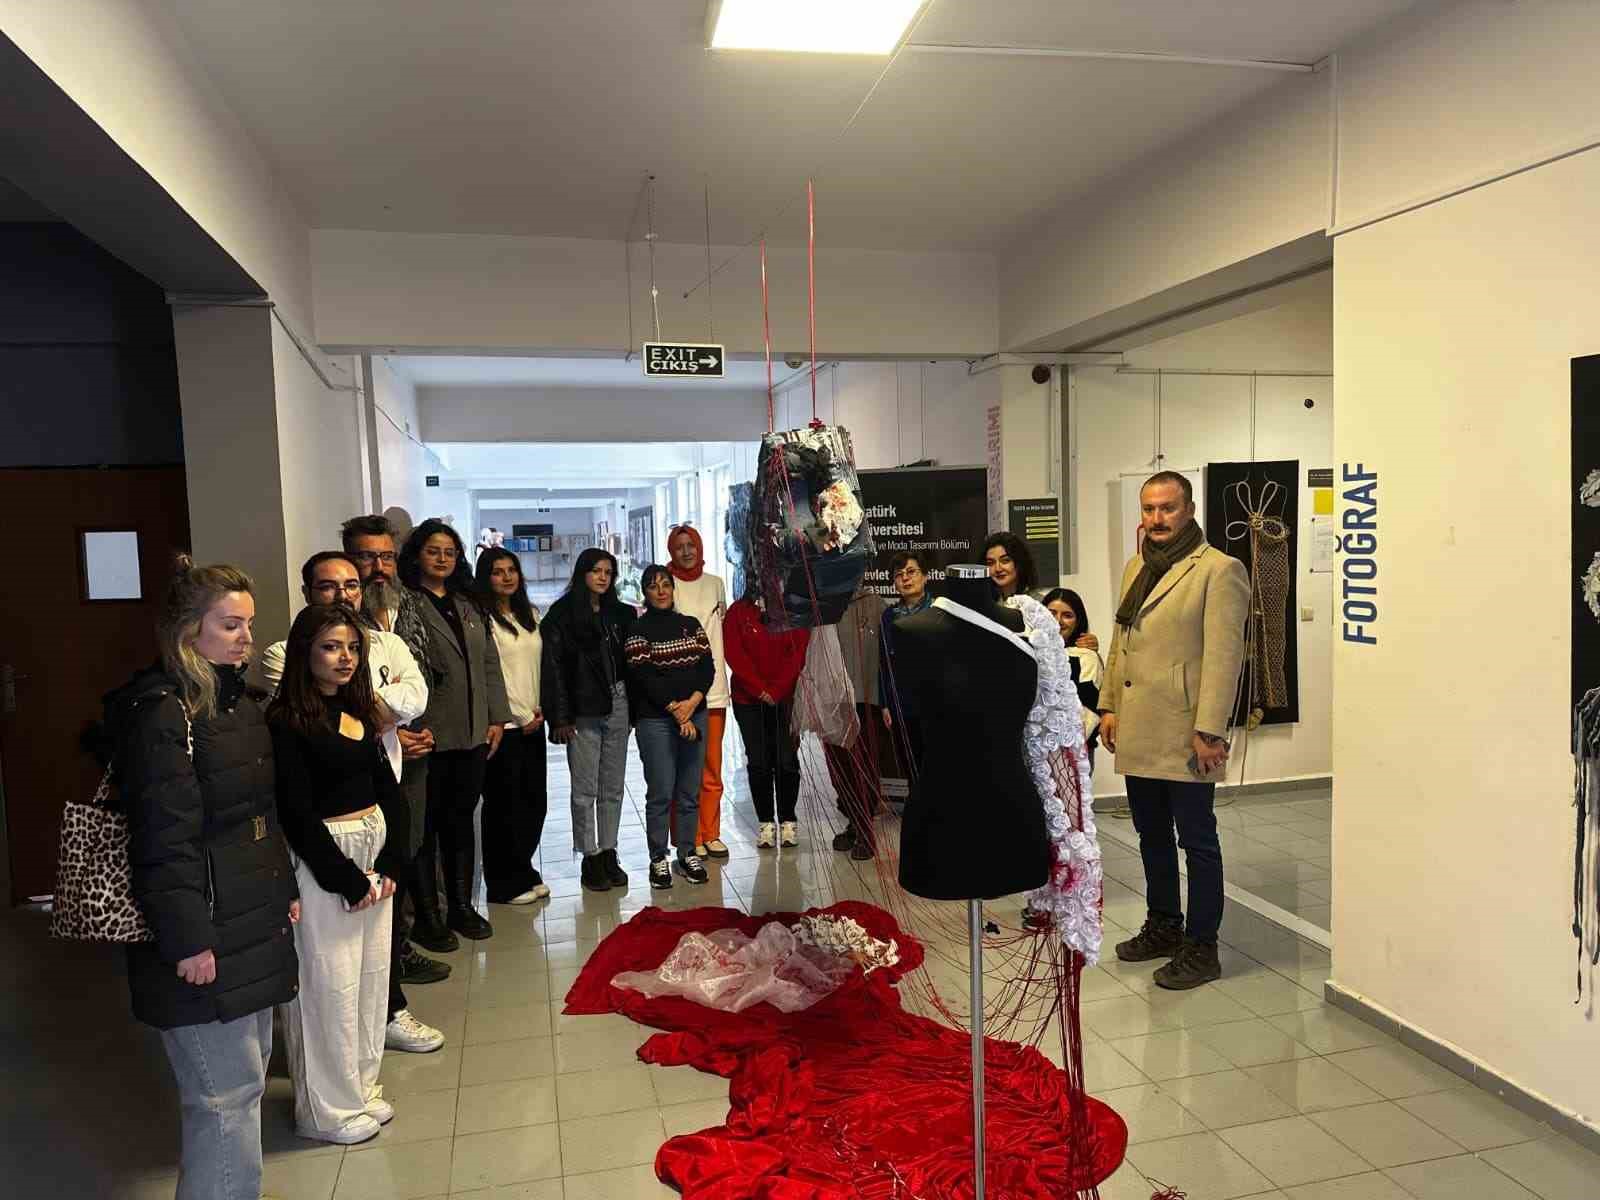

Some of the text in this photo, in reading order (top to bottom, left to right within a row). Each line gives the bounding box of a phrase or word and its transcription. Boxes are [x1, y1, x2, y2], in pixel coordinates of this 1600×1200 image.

[651, 348, 696, 360] EXIT
[650, 360, 698, 373] ÇIKIŞ
[865, 505, 897, 518] atürk
[868, 522, 924, 536] iversitesi
[887, 541, 908, 550] Moda
[1335, 463, 1377, 645] FOTOĞRAF
[864, 569, 890, 581] evlet
